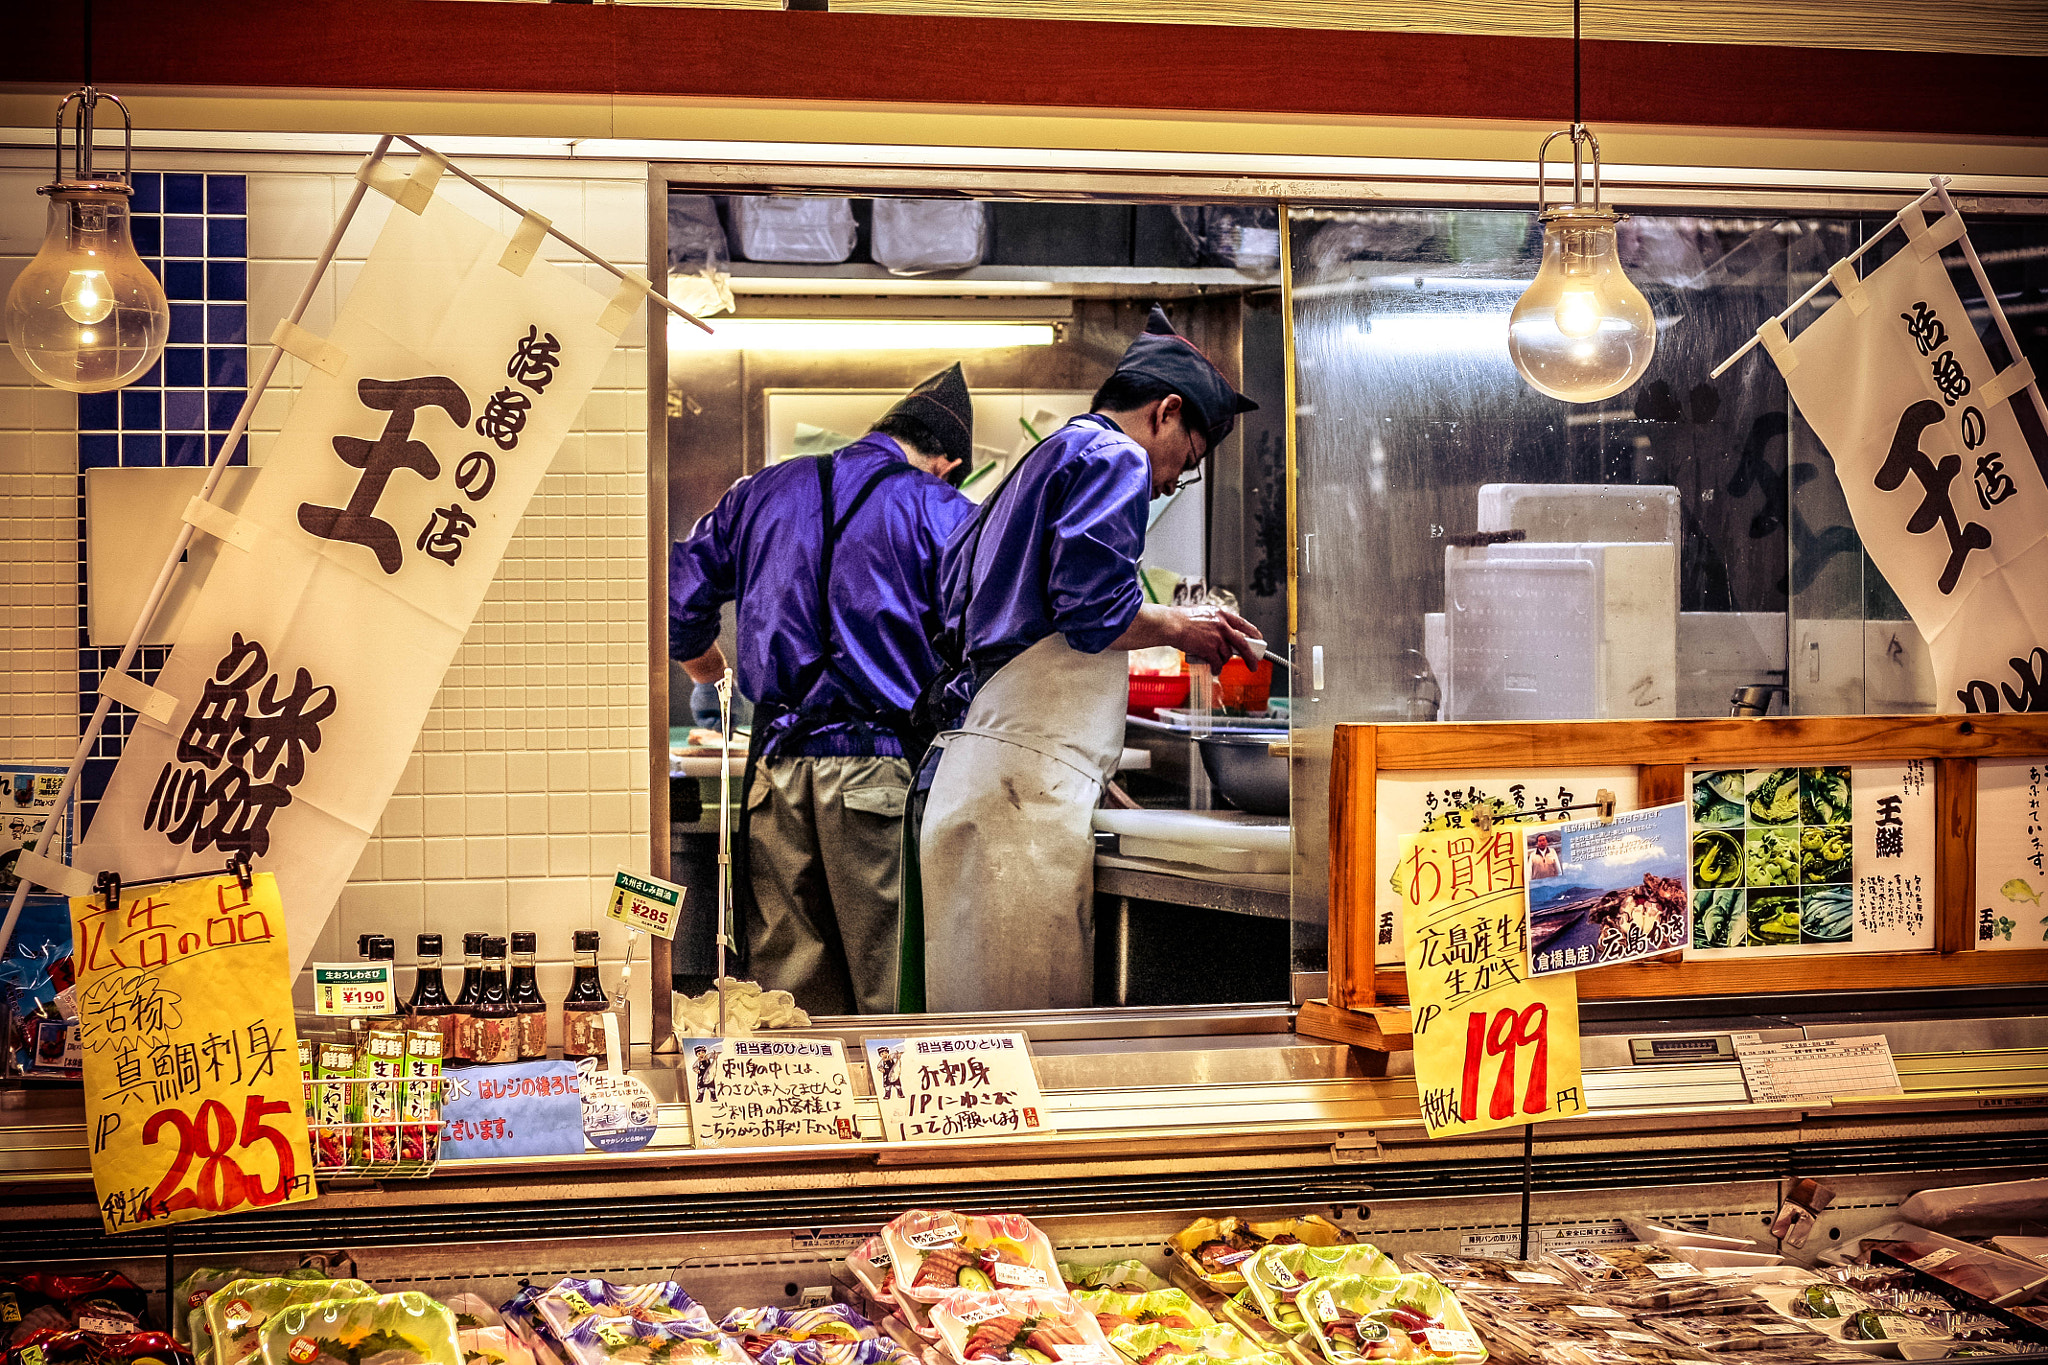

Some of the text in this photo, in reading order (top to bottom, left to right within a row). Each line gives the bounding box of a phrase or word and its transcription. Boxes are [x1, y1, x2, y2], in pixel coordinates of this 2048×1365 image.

[1900, 301, 2018, 511] 活魚の店
[415, 323, 562, 567] 活魚の店
[2027, 766, 2045, 876] あふれています。
[631, 901, 669, 924] ¥285
[325, 970, 380, 980] 生おろしわさび
[1444, 956, 1522, 1000] 生ガキ
[343, 991, 385, 1003] ¥190
[735, 1042, 834, 1057] 担当者のひとり言
[917, 1038, 1015, 1054] 担当者のひとり言
[1461, 1002, 1550, 1122] 199
[1556, 1087, 1580, 1113] 円
[478, 1074, 580, 1100] はレジの後ろに
[917, 1056, 991, 1091] お刺身
[141, 1093, 296, 1213] 285
